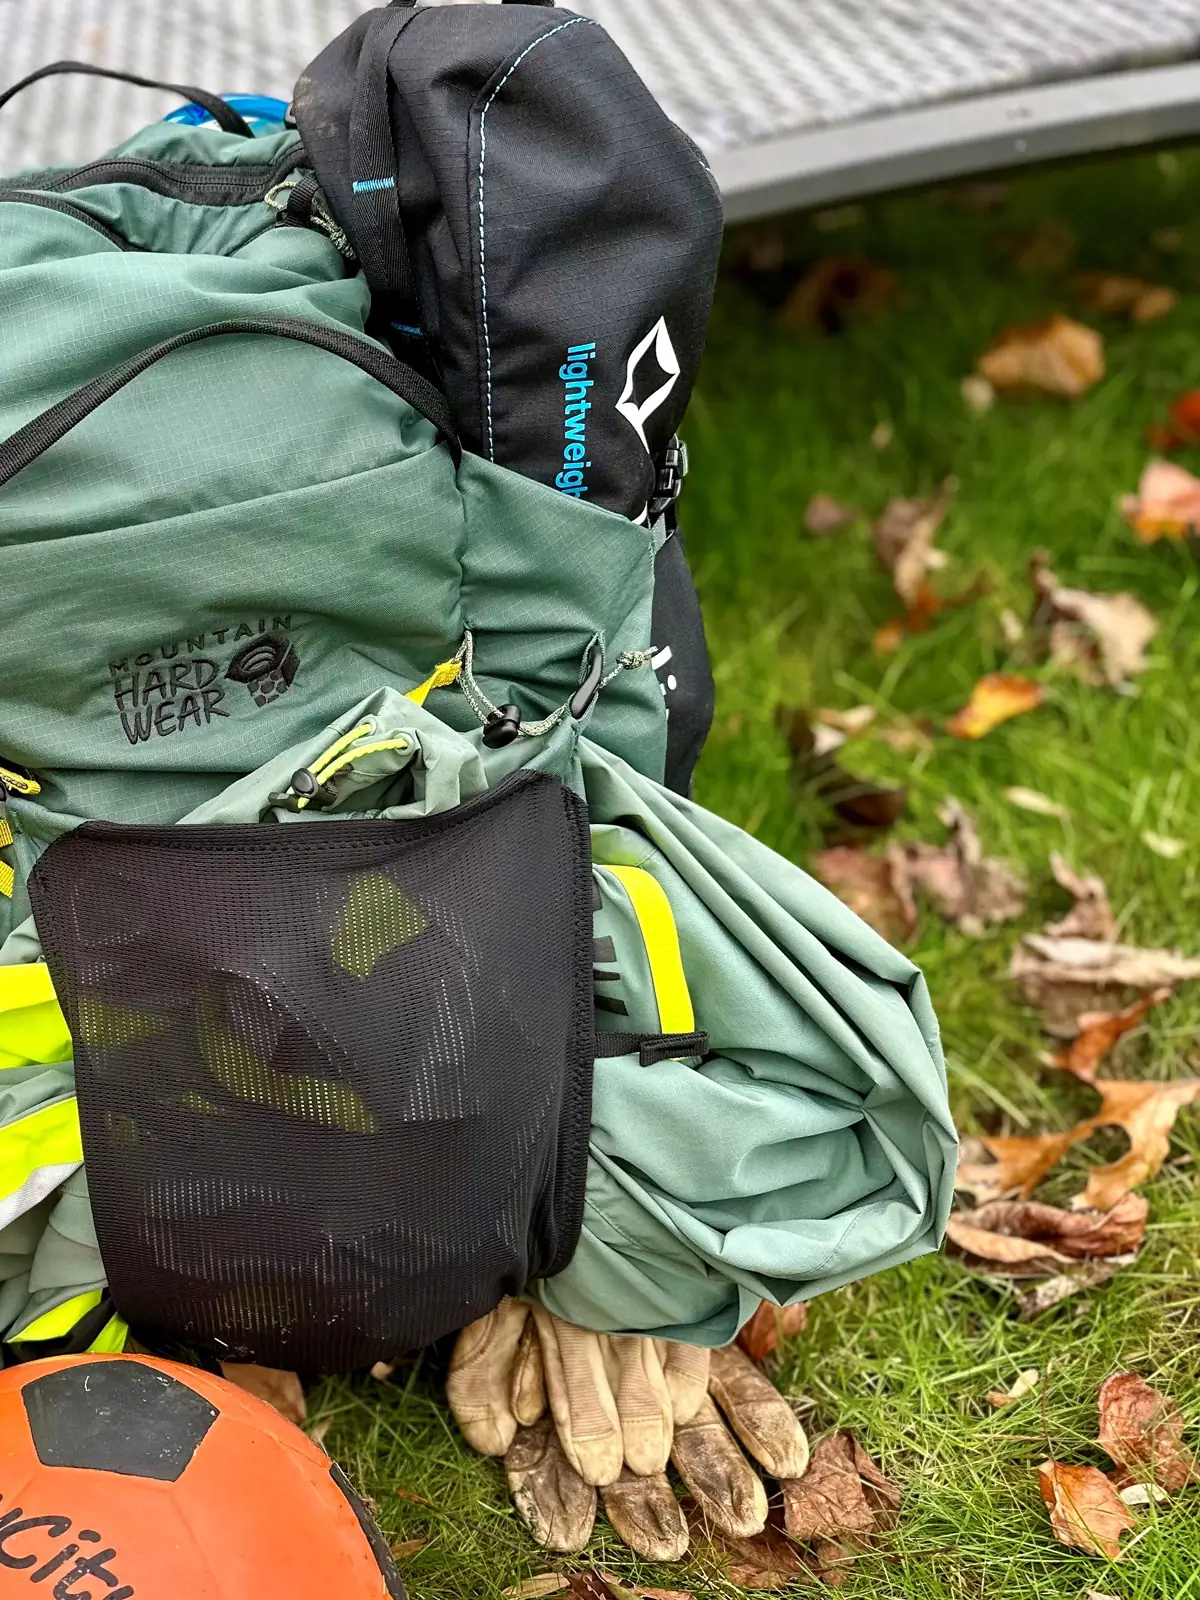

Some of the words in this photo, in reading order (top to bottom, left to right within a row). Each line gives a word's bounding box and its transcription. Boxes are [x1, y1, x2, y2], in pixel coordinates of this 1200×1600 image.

[108, 614, 292, 674] MOUNTAIN
[115, 658, 220, 711] HARD
[119, 689, 231, 745] WEAR
